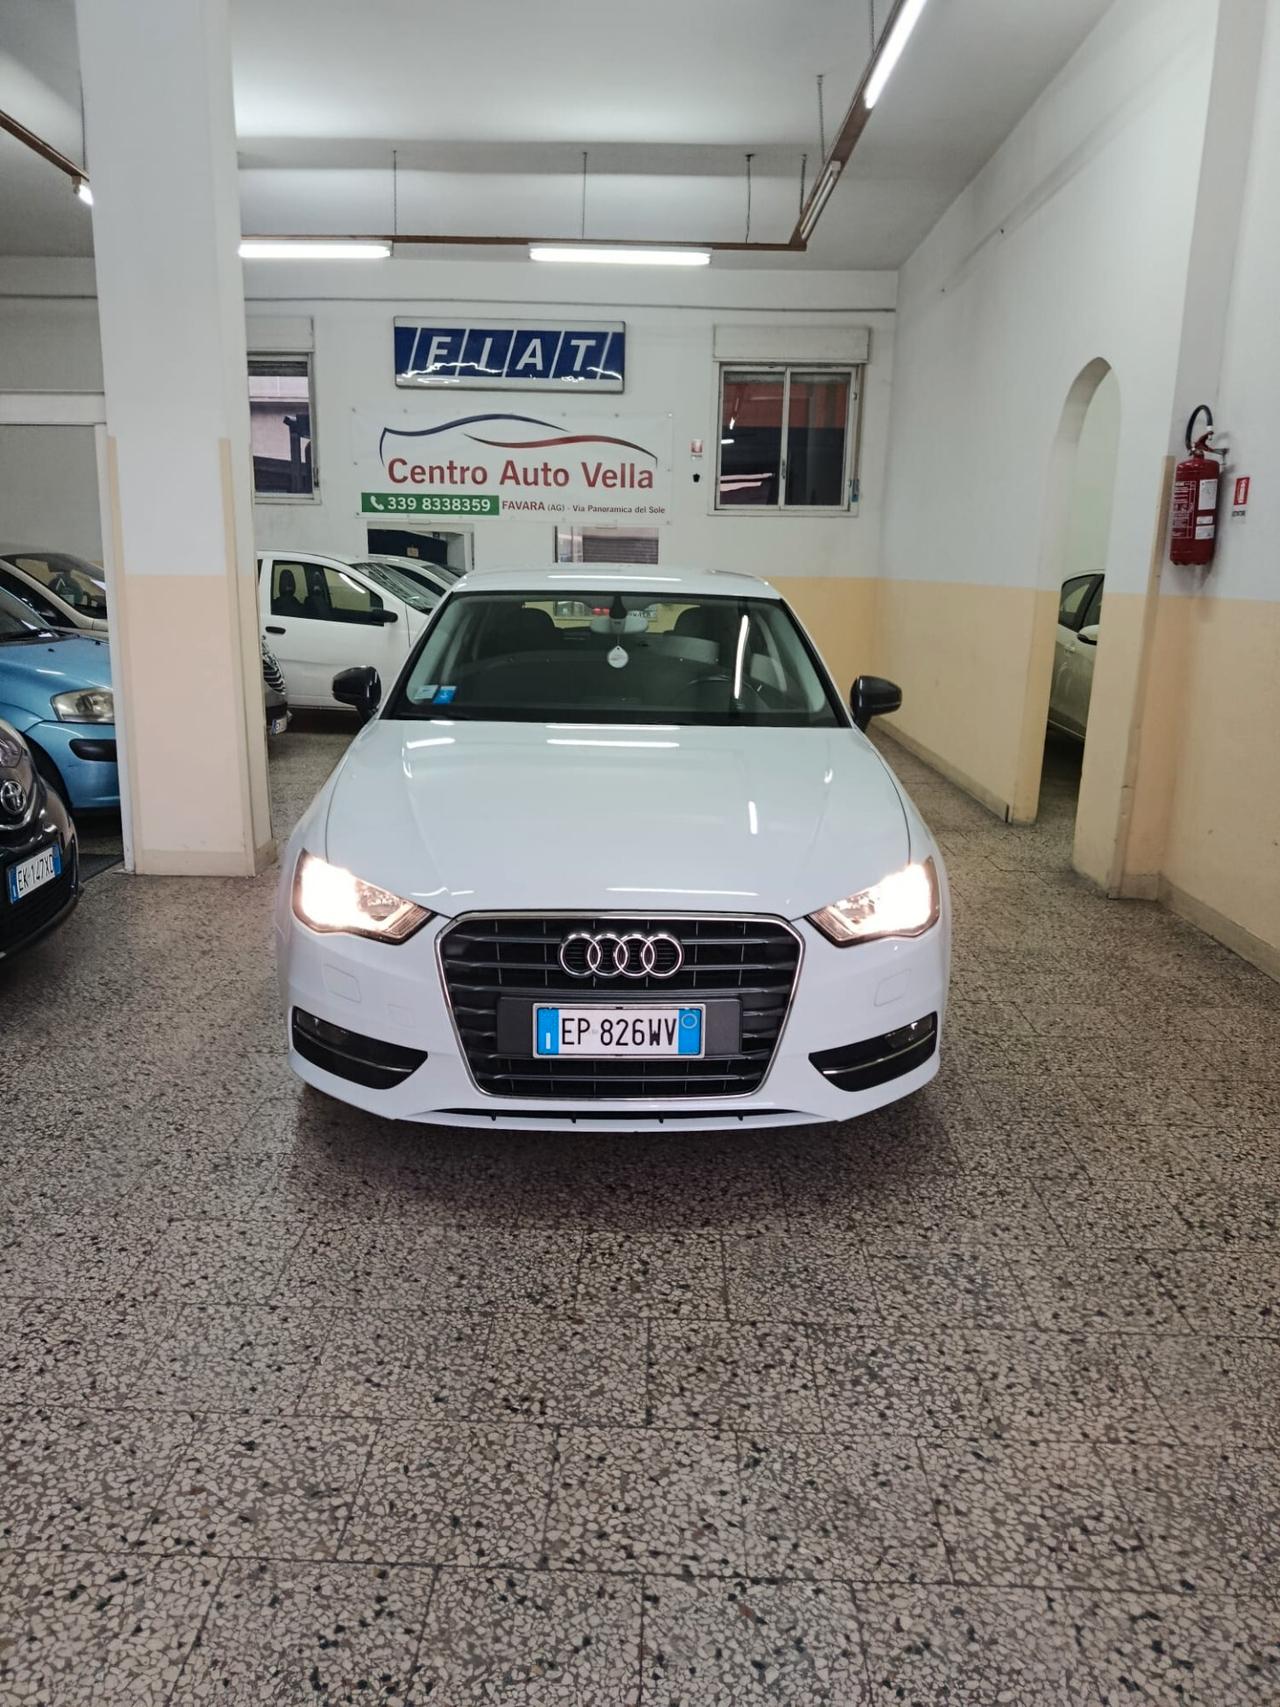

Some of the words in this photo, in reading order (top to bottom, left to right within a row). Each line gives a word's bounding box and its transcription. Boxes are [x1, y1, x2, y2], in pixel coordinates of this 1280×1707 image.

[426, 335, 597, 372] FIAT
[387, 457, 488, 486] Centro
[499, 460, 570, 488] Auto
[581, 461, 654, 489] Vella
[387, 496, 417, 511] 339
[422, 497, 491, 512] 8338359
[502, 500, 545, 512] FAVARA
[547, 503, 565, 513] (AG)
[573, 504, 585, 513] Via
[588, 504, 632, 514] Panoramica
[635, 505, 646, 514] del
[649, 505, 666, 515] Sole
[561, 1018, 591, 1045] EP
[600, 1018, 677, 1046] 826WV
